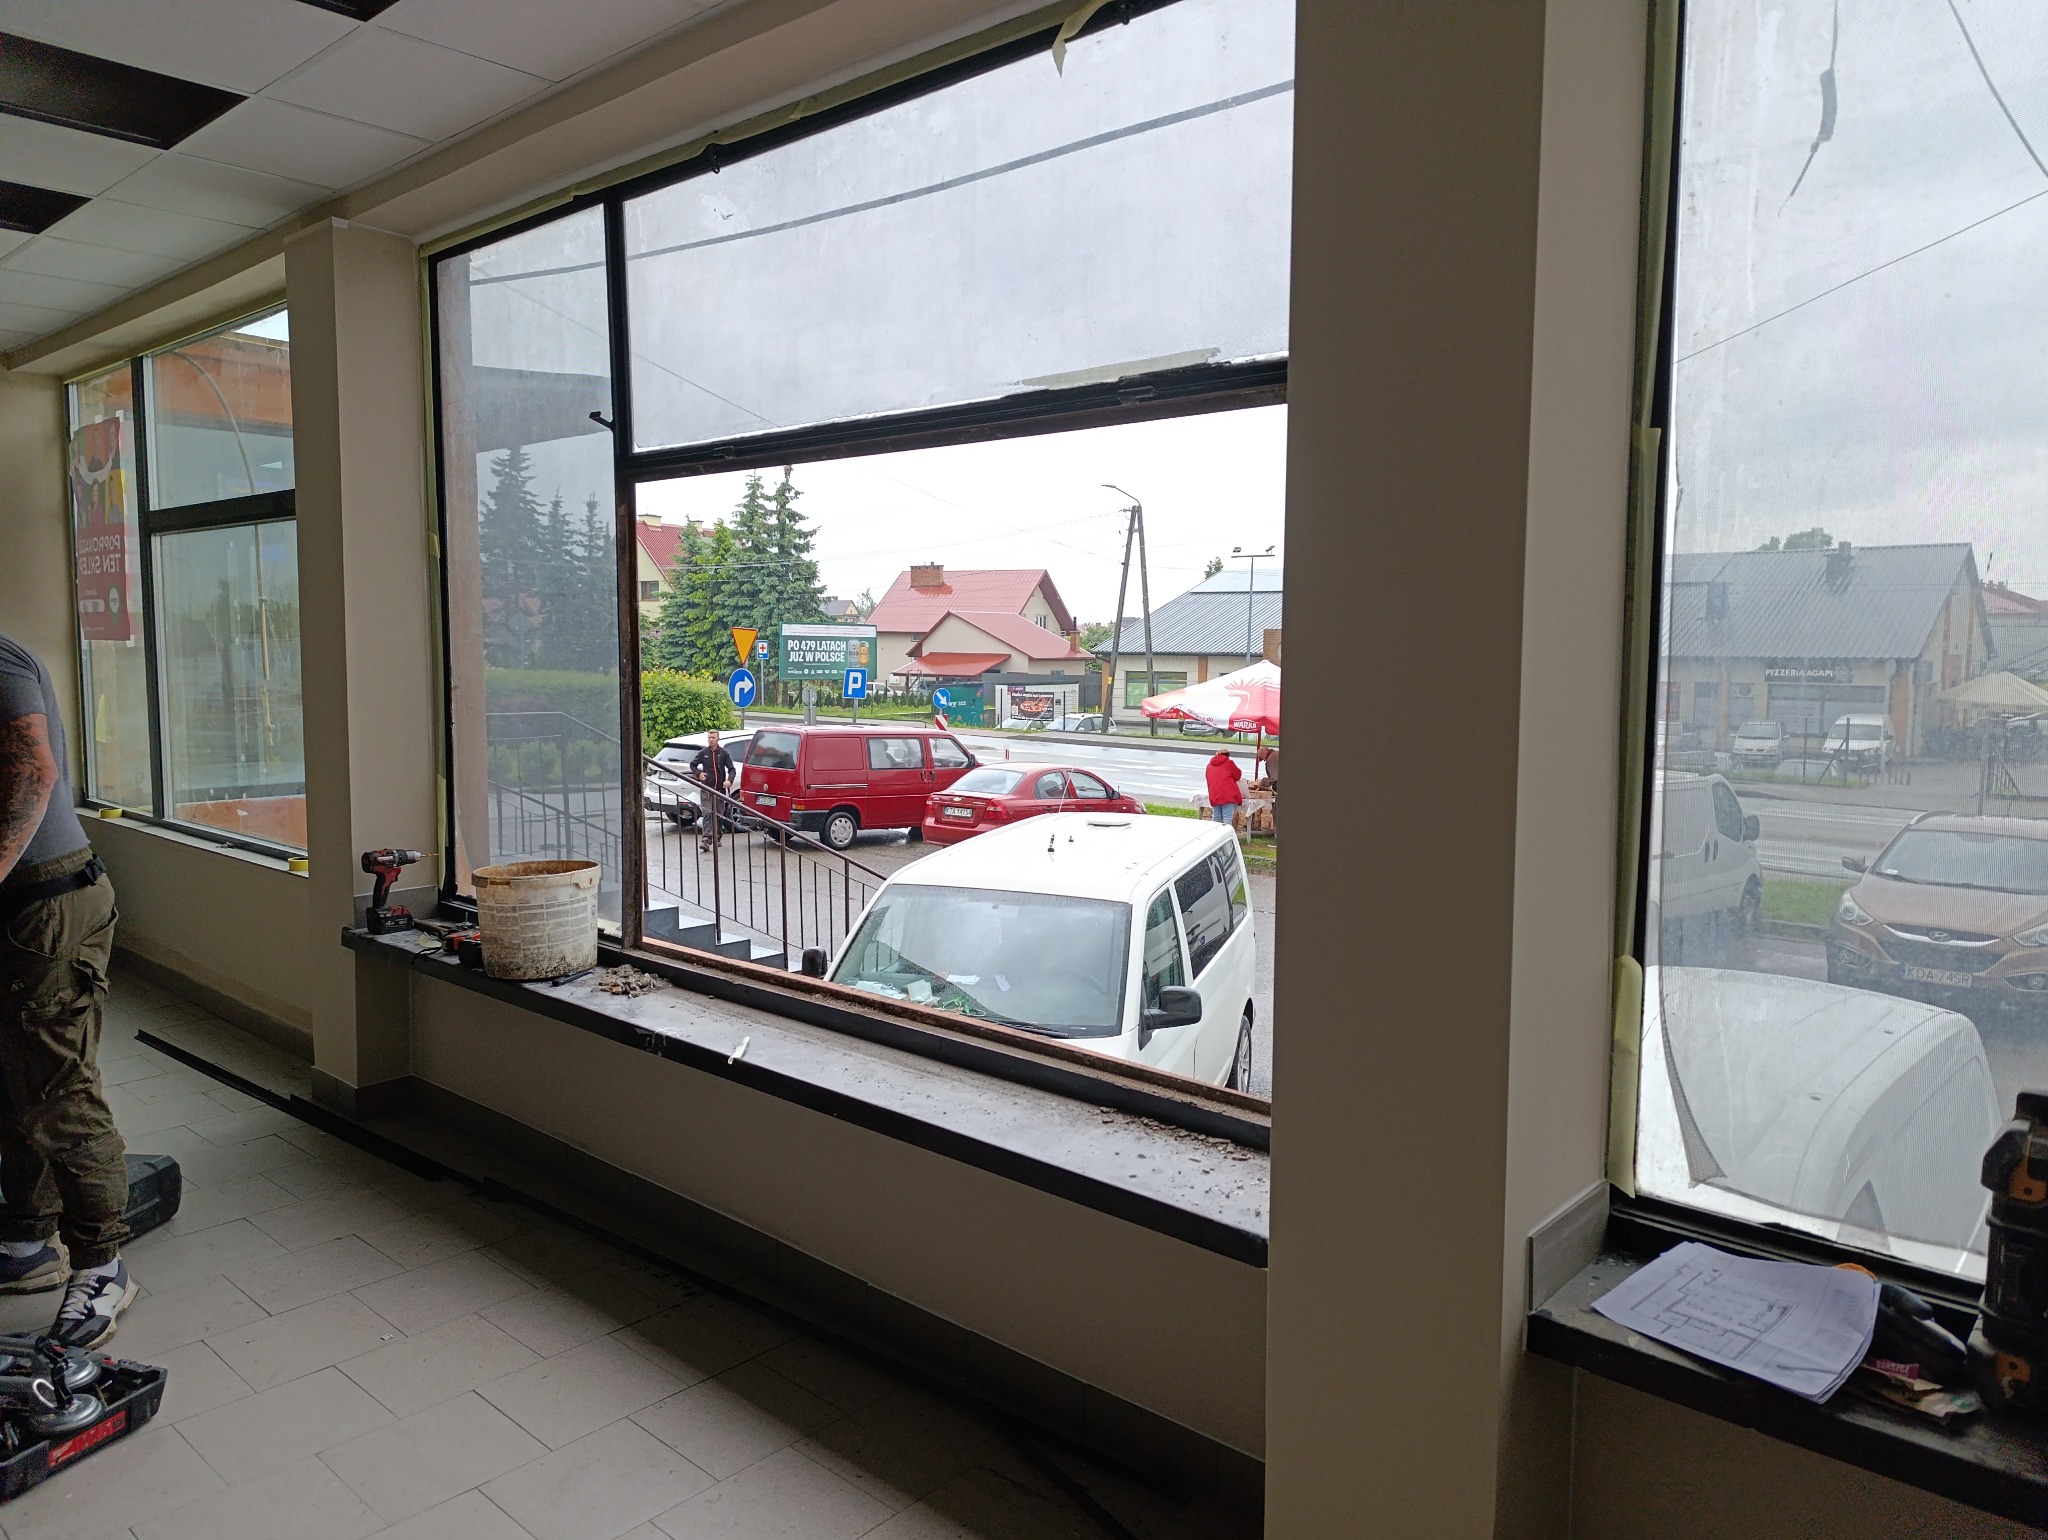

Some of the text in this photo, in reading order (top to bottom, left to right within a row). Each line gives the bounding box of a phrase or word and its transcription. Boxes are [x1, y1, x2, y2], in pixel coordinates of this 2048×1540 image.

[787, 640, 846, 652] PO 479 LATACH
[788, 649, 804, 662] JUŻ
[805, 651, 814, 662] W
[815, 652, 845, 662] POLSCE
[1765, 668, 1833, 678] PIZZERIA AGAPI
[848, 671, 863, 695] P
[1233, 719, 1258, 730] WARKA
[1906, 967, 1934, 980] KDA
